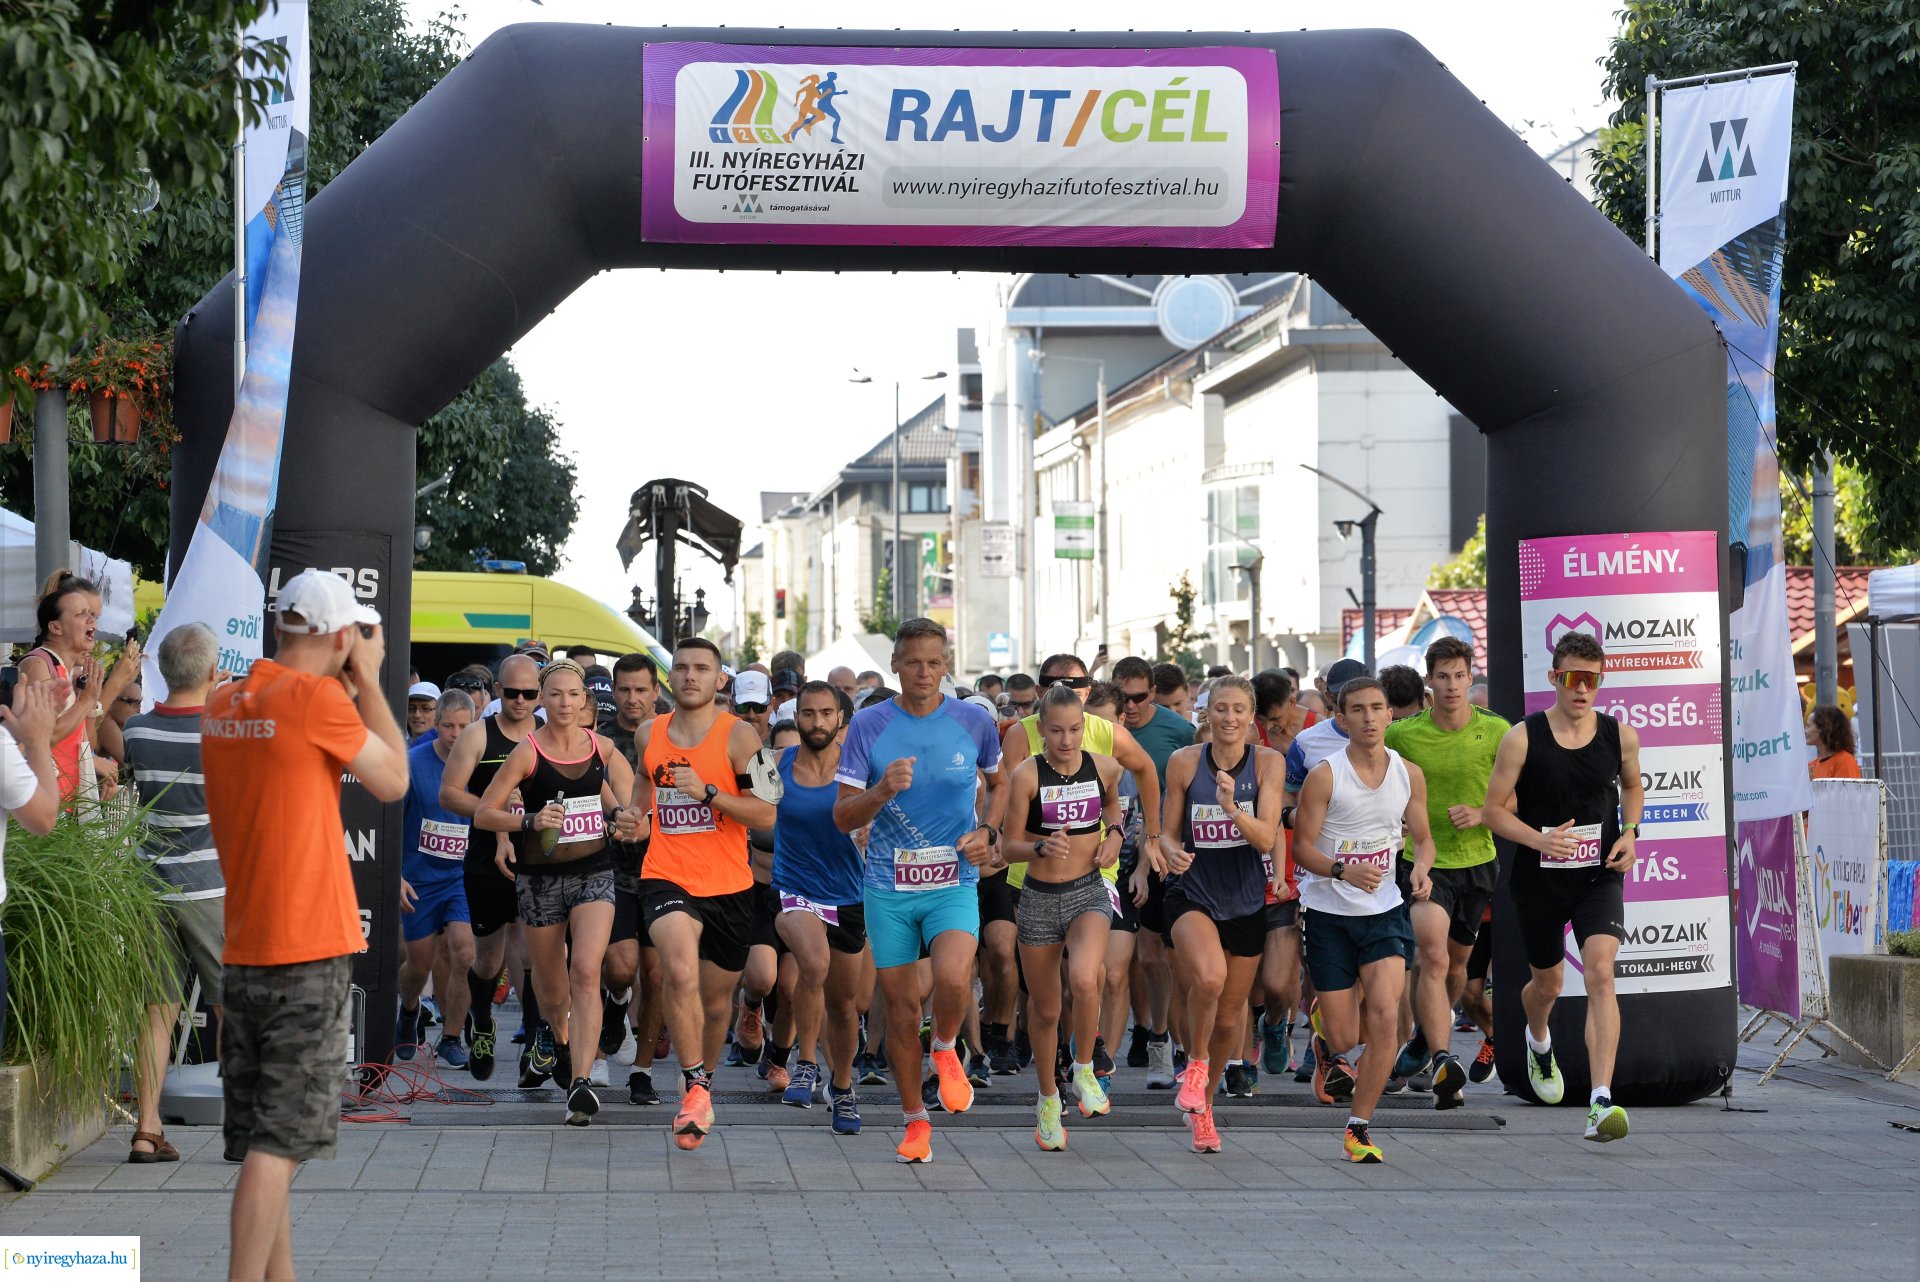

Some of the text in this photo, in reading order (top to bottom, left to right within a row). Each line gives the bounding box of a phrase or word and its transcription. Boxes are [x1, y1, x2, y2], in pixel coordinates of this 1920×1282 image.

[885, 76, 1229, 147] RAJT/CÉL
[267, 114, 288, 131] WITTUR
[689, 148, 865, 171] III. NYÍREGYHÁZI
[692, 170, 860, 193] FUTÓFESZTIVÁL
[892, 177, 1219, 200] www.nyiregyhazifutofesztival.hu
[1710, 188, 1741, 204] WITTUR
[769, 203, 830, 212] támogatásával
[1563, 544, 1685, 578] ÉLMÉNY.
[1605, 618, 1696, 640] MOZAIK
[1675, 638, 1697, 648] med
[1605, 654, 1686, 669] NYÍREGYHÁZA
[1682, 790, 1704, 800] med
[659, 806, 712, 825] 10009
[1057, 800, 1089, 821] 557
[1643, 808, 1688, 820] RECEN
[563, 814, 603, 834] 0018
[1195, 823, 1242, 840] 1016
[421, 834, 466, 853] 10132
[897, 863, 957, 883] 10027
[1621, 922, 1708, 946] MOZAIK
[1688, 941, 1709, 953] med
[1621, 960, 1698, 974] TOKAJI-HEGY
